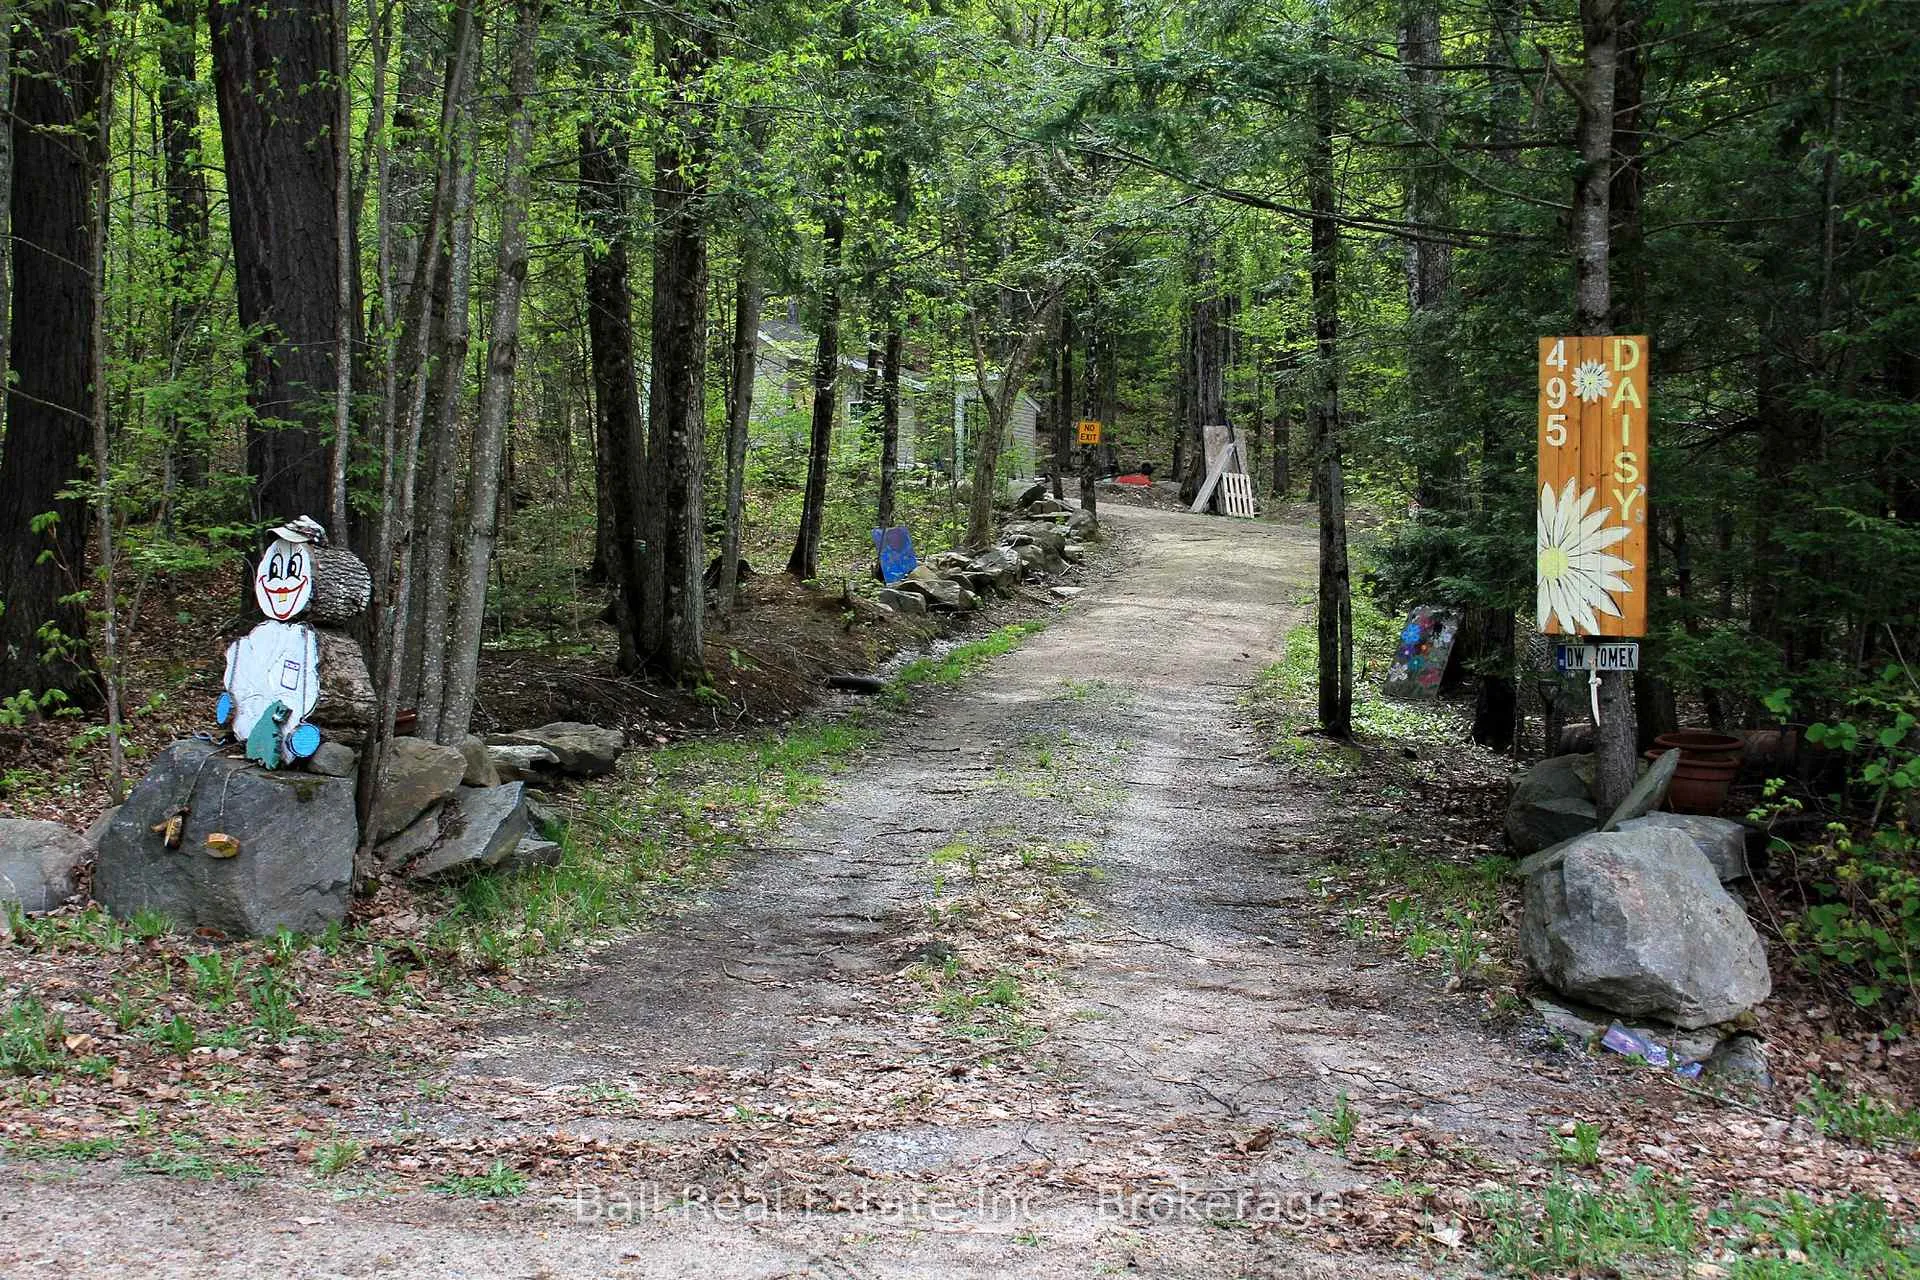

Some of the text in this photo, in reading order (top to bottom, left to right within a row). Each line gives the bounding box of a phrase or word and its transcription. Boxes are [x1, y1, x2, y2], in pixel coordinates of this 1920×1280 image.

[1545, 339, 1568, 447] 495
[1084, 424, 1096, 432] NO
[1080, 433, 1097, 441] EXIT
[1567, 647, 1585, 667] DW
